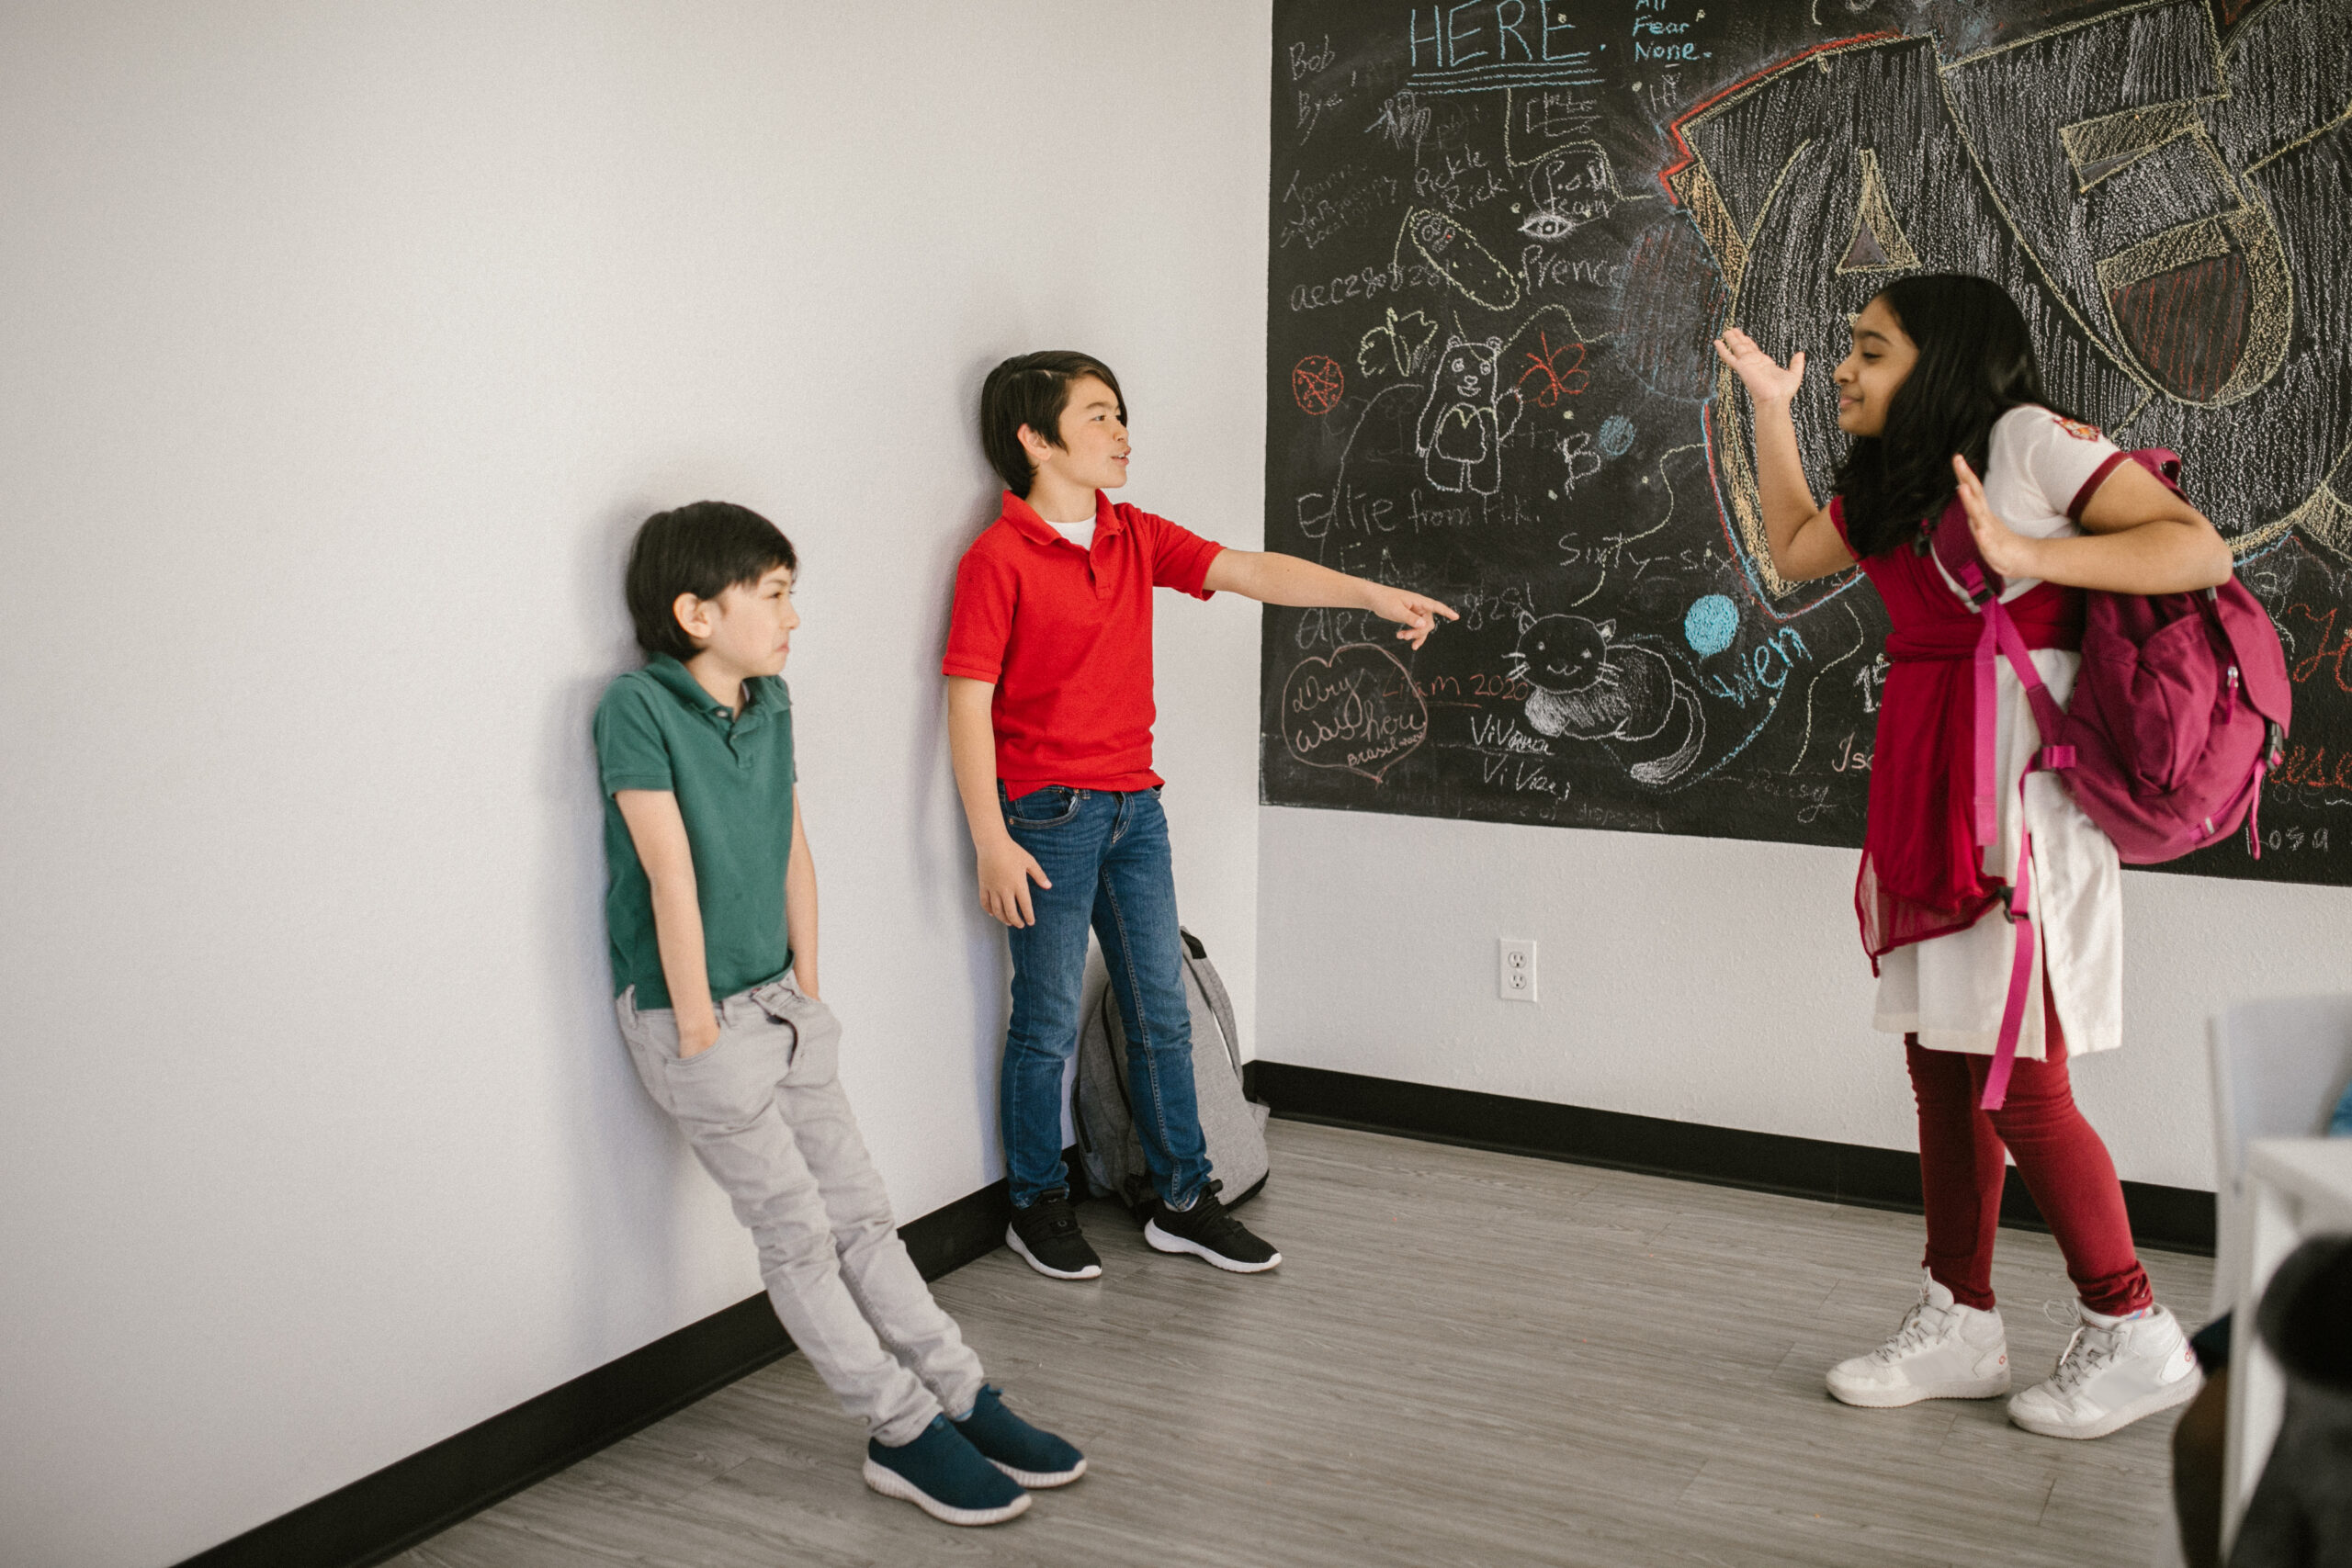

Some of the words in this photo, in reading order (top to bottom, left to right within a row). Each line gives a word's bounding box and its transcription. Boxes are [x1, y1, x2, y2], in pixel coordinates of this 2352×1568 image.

[1632, 14, 1690, 37] Fear
[1288, 34, 1335, 81] Bob
[1296, 483, 1396, 538] Ellie
[1470, 672, 1529, 701] 2020
